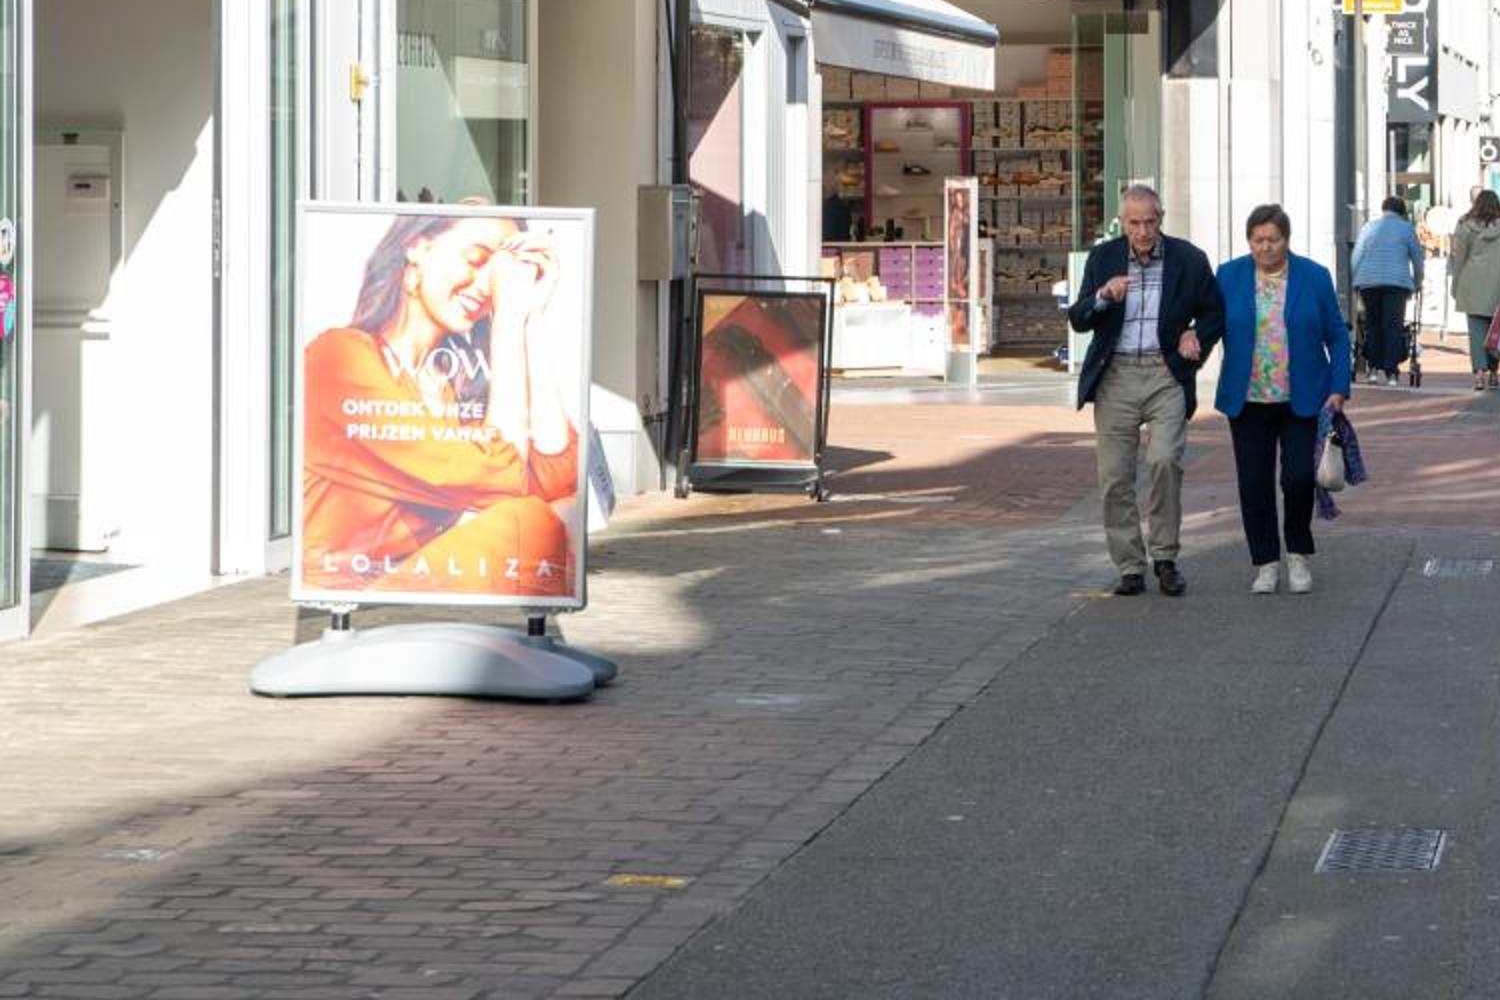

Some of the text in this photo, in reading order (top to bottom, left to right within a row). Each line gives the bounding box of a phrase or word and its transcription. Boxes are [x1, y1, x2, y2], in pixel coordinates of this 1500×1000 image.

[342, 400, 425, 417] ONTDEK
[347, 423, 426, 440] PRIJZEN
[323, 554, 553, 577] LOLALIZA
